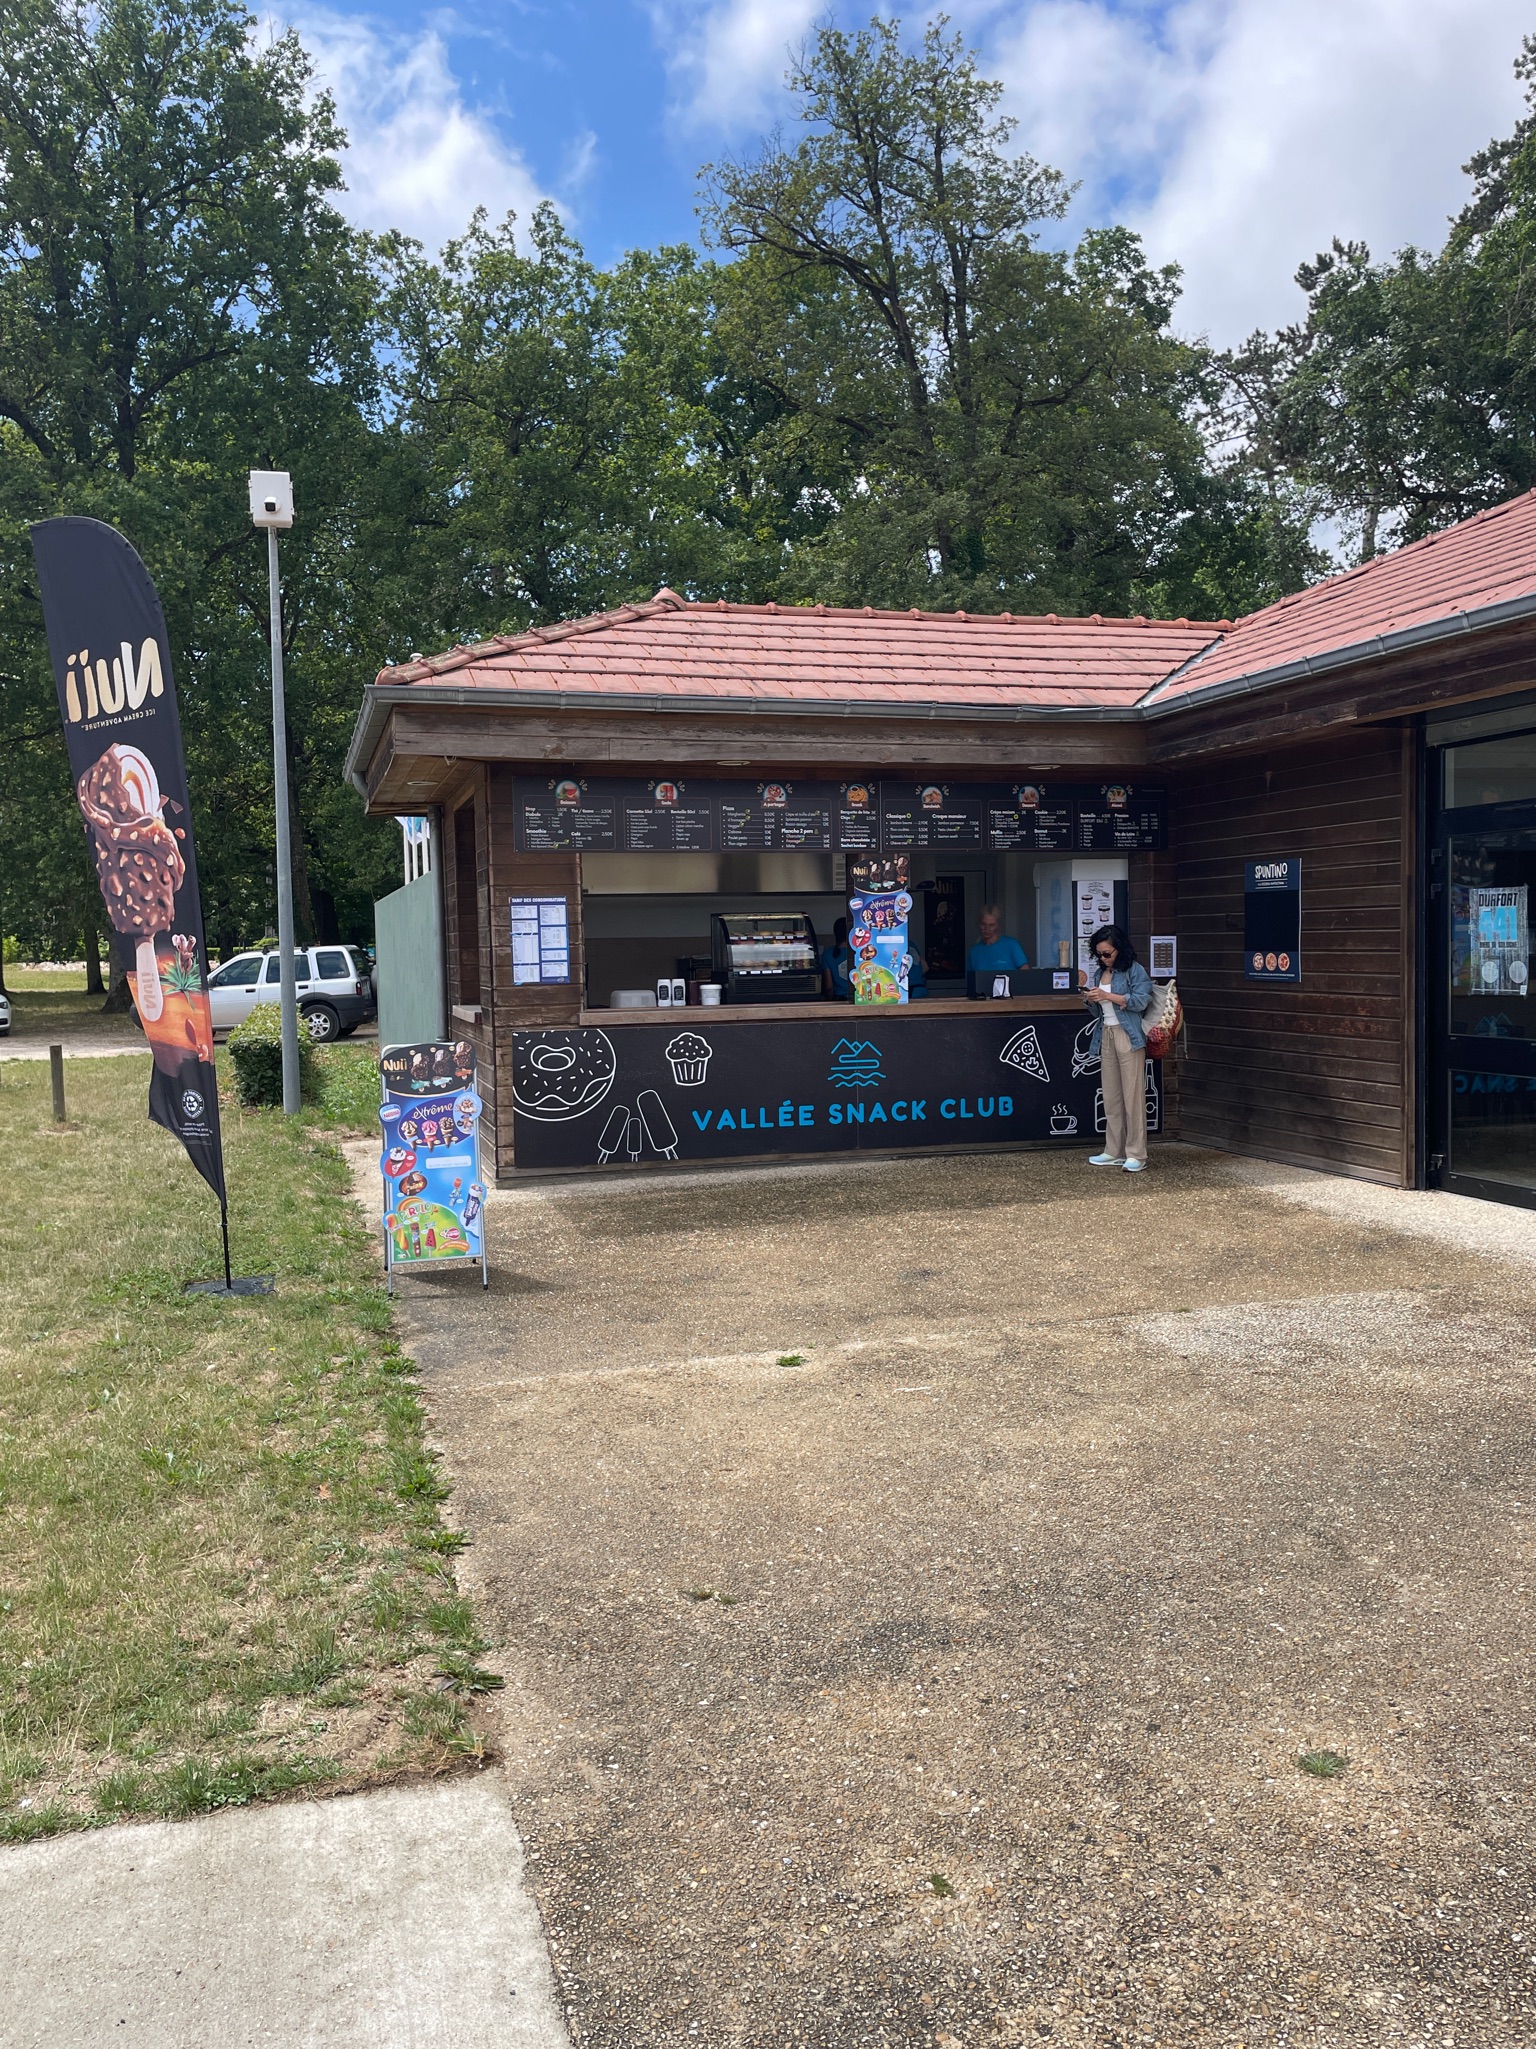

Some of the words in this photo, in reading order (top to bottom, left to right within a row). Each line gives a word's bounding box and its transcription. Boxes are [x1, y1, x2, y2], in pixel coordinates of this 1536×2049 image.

[1478, 892, 1519, 907] DURFORT
[692, 1099, 815, 1131] VALLÉE
[828, 1099, 928, 1124] SNACK
[940, 1095, 1014, 1120] CLUB
